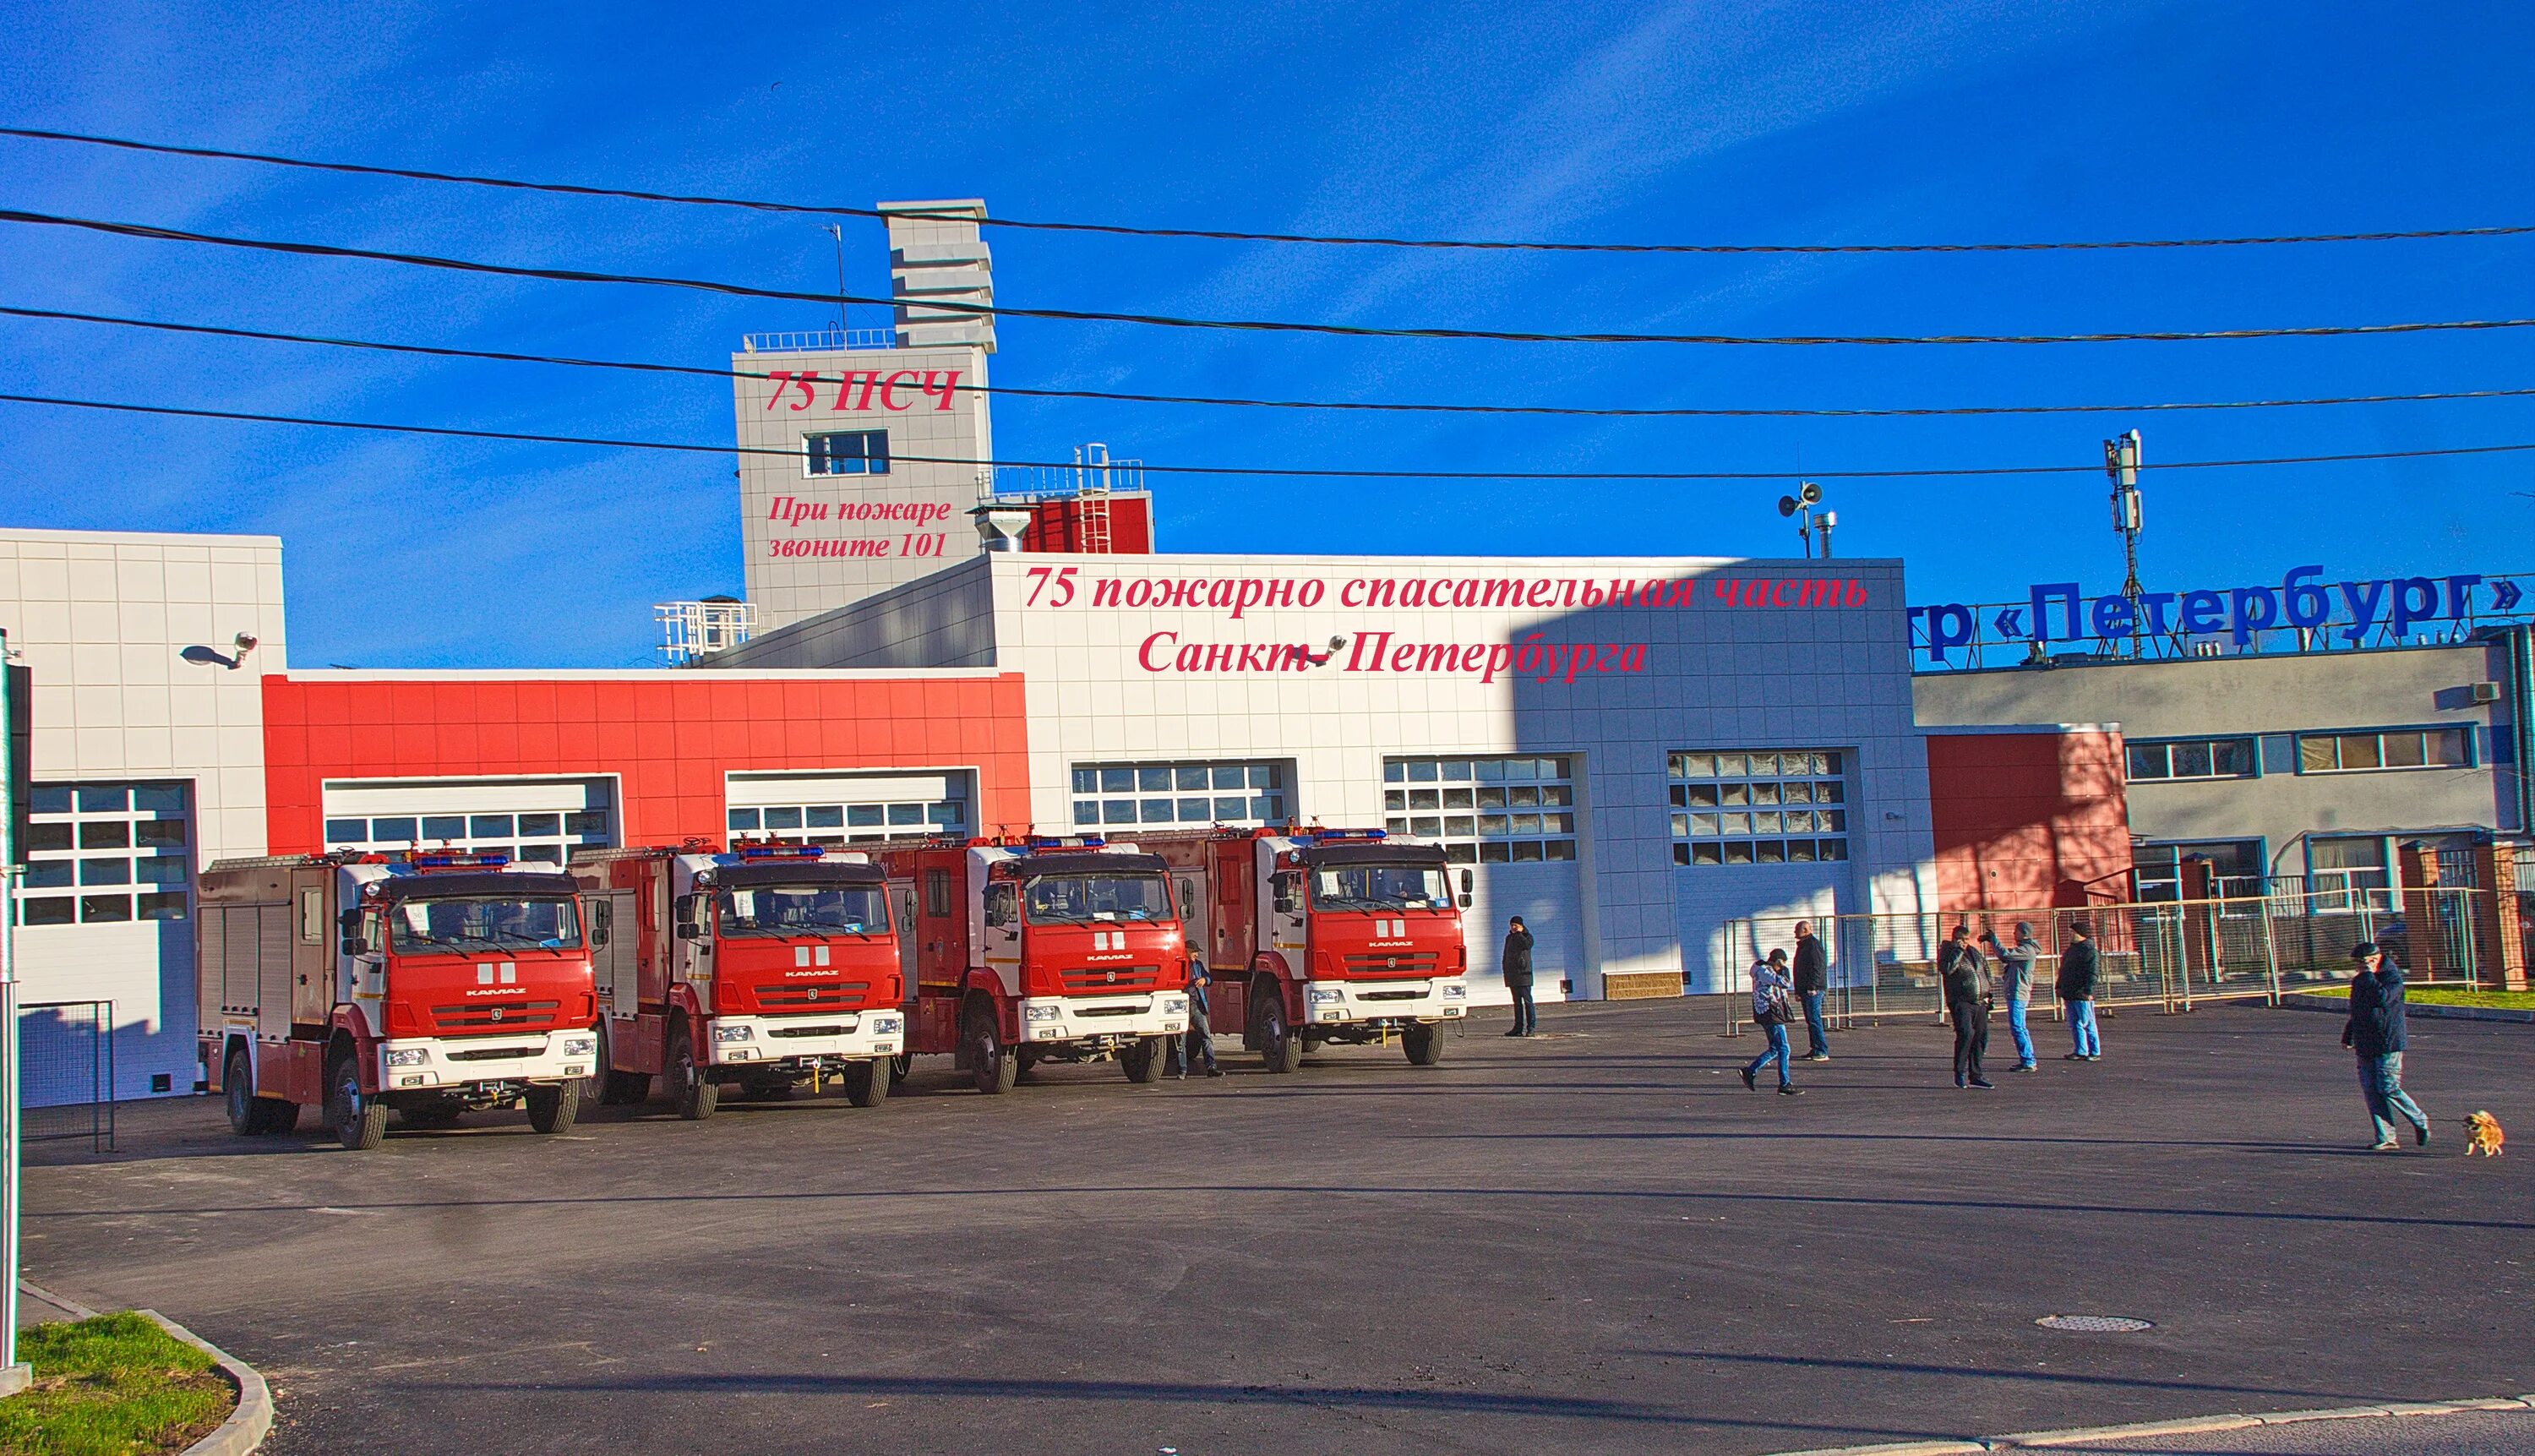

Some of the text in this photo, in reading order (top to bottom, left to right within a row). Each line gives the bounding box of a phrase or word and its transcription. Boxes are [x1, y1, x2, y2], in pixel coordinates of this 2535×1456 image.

[1993, 564, 2523, 646] «Петербург»
[785, 969, 840, 978] KAMAZ
[466, 988, 526, 996] KAMAZ
